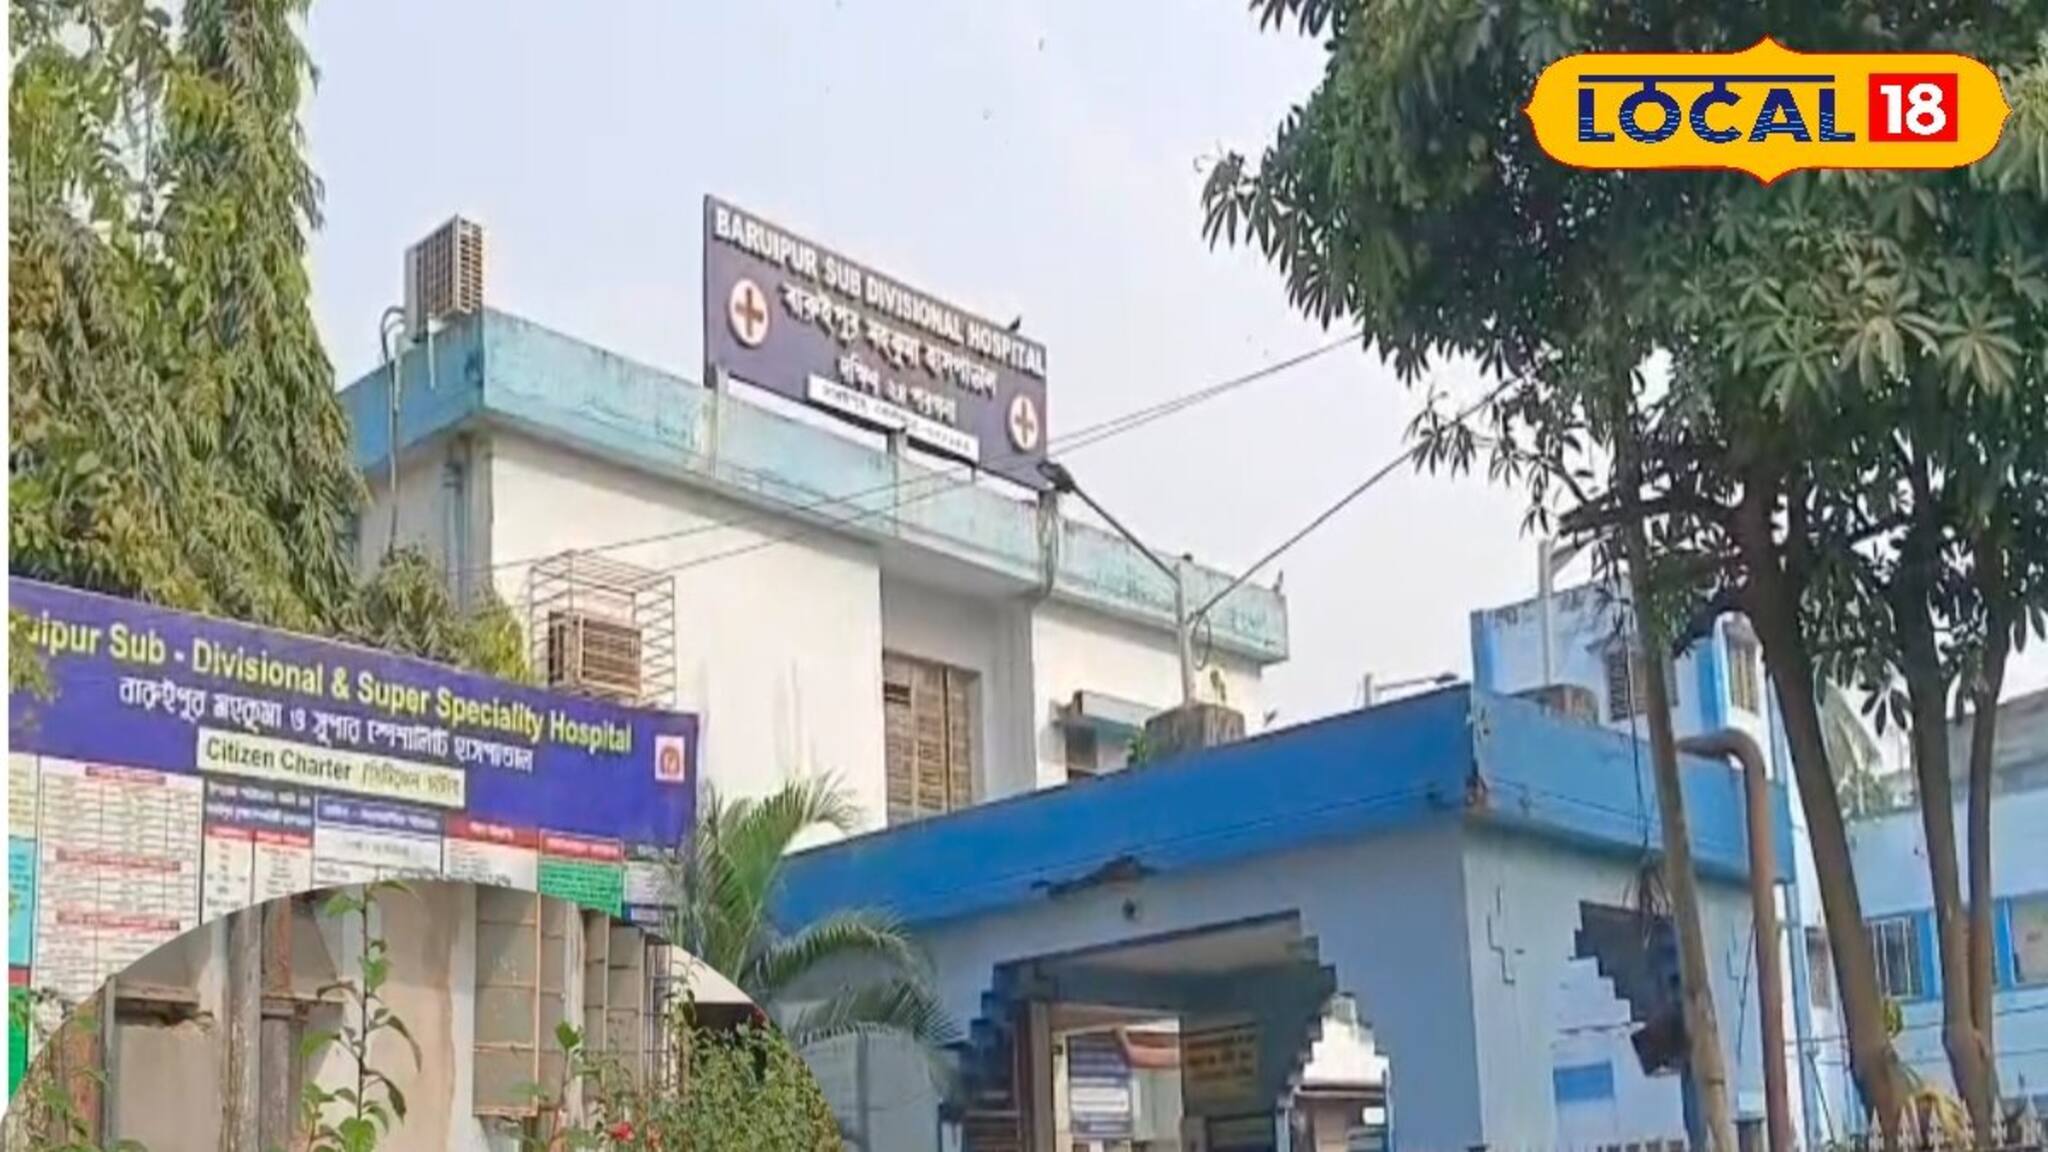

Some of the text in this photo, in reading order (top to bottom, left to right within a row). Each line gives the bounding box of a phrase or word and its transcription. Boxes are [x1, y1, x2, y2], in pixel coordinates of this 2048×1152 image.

[714, 207, 1046, 376] BARUIPUR SUB DIVISIONAL HOSPITAL
[110, 622, 165, 665] Sub
[192, 637, 324, 697] Divisional
[331, 669, 349, 699] &
[358, 670, 429, 719] Super
[436, 687, 546, 744] Speciality
[549, 709, 632, 755] Hospital
[119, 676, 207, 724] বারুইপুর
[213, 693, 283, 732] মহকুমা
[290, 706, 307, 731] ও
[311, 709, 361, 748] সুপার
[454, 735, 534, 773] হাসপাতাল
[206, 736, 352, 781] Citizen Charter
